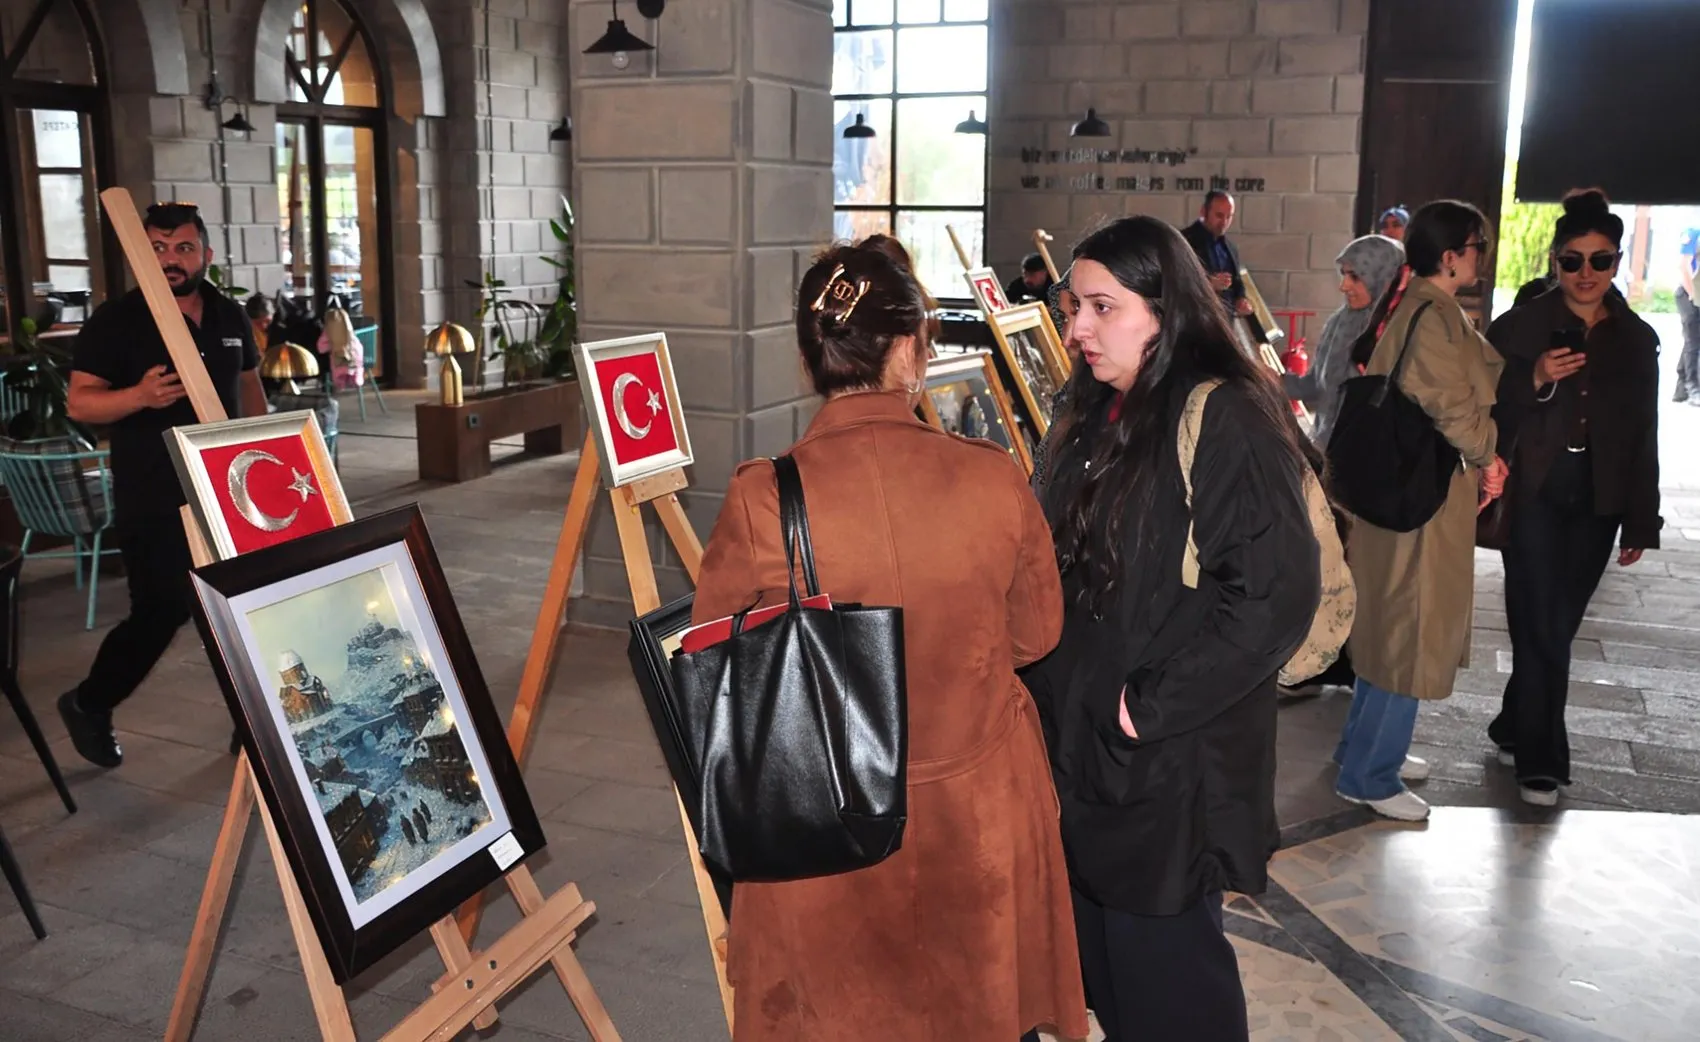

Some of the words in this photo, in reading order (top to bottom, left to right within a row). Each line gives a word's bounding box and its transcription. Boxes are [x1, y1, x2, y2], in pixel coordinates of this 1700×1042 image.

[1021, 175, 1040, 189] we
[1171, 173, 1204, 191] rom
[1210, 174, 1229, 190] the
[1234, 177, 1265, 192] core
